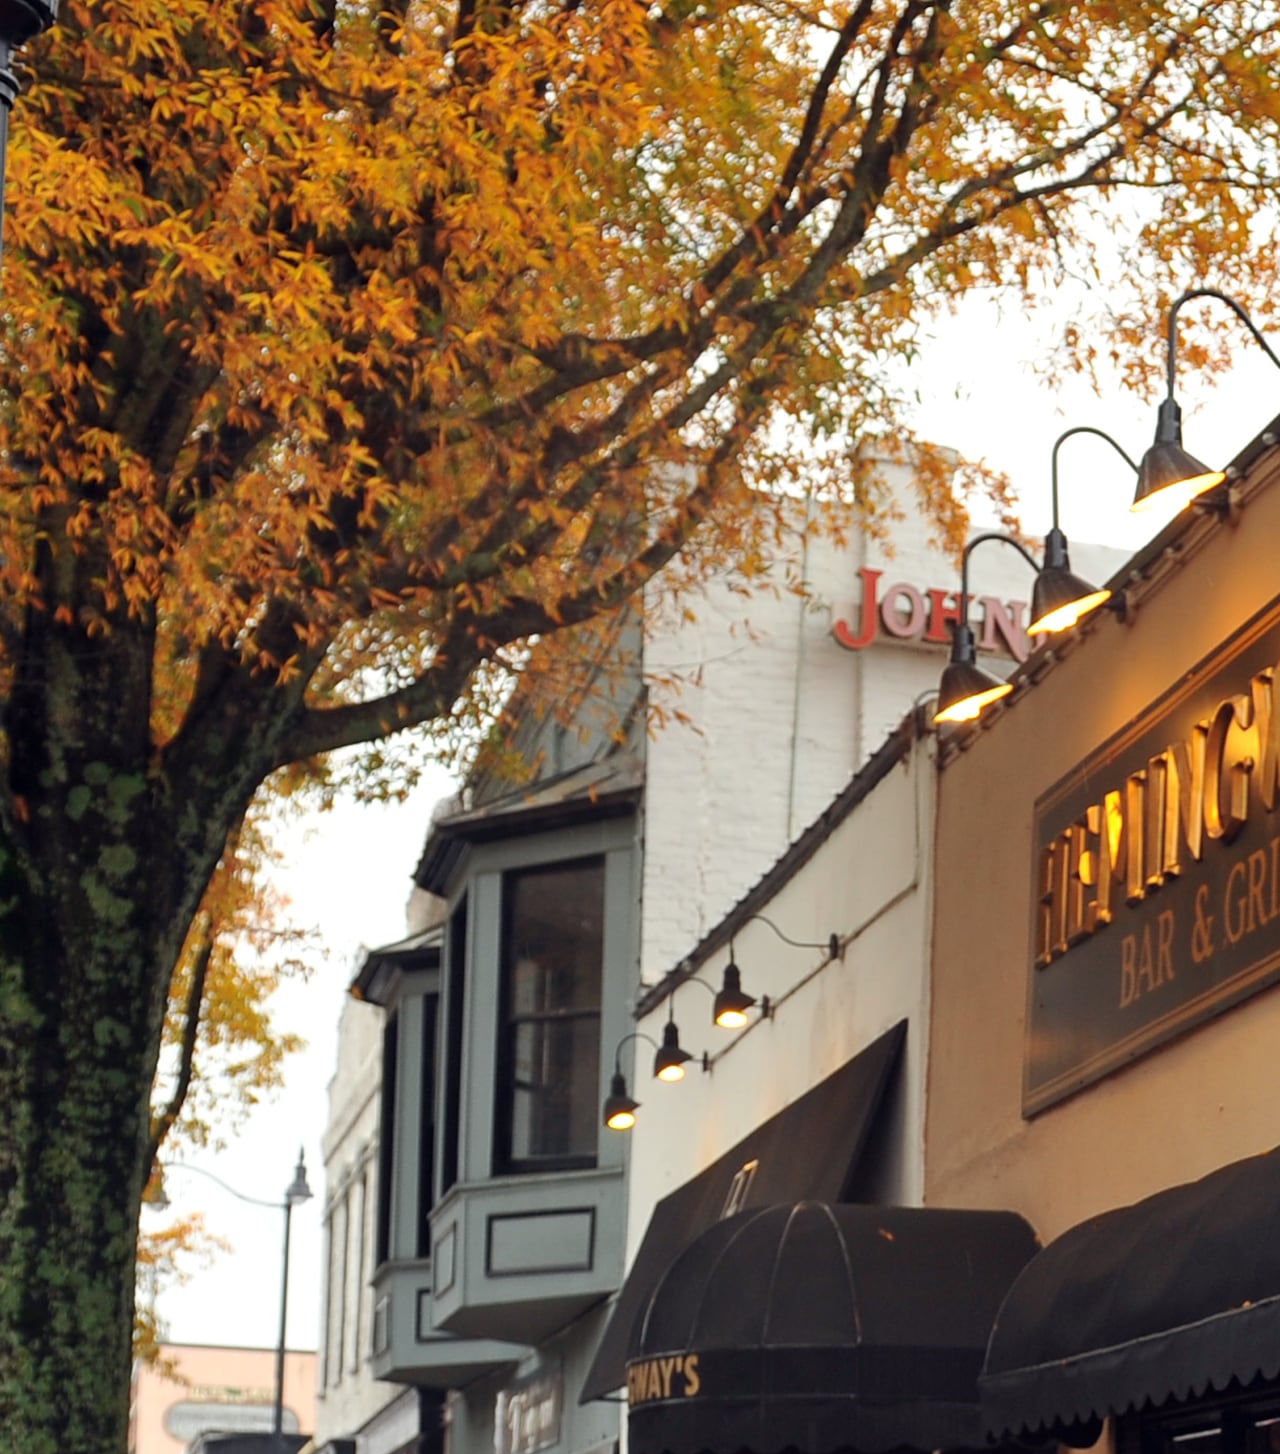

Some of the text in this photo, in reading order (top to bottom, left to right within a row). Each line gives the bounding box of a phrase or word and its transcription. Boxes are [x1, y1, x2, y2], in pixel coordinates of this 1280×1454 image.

[835, 567, 1046, 664] JOHN
[1120, 916, 1175, 1009] BAR
[1191, 881, 1216, 964] &
